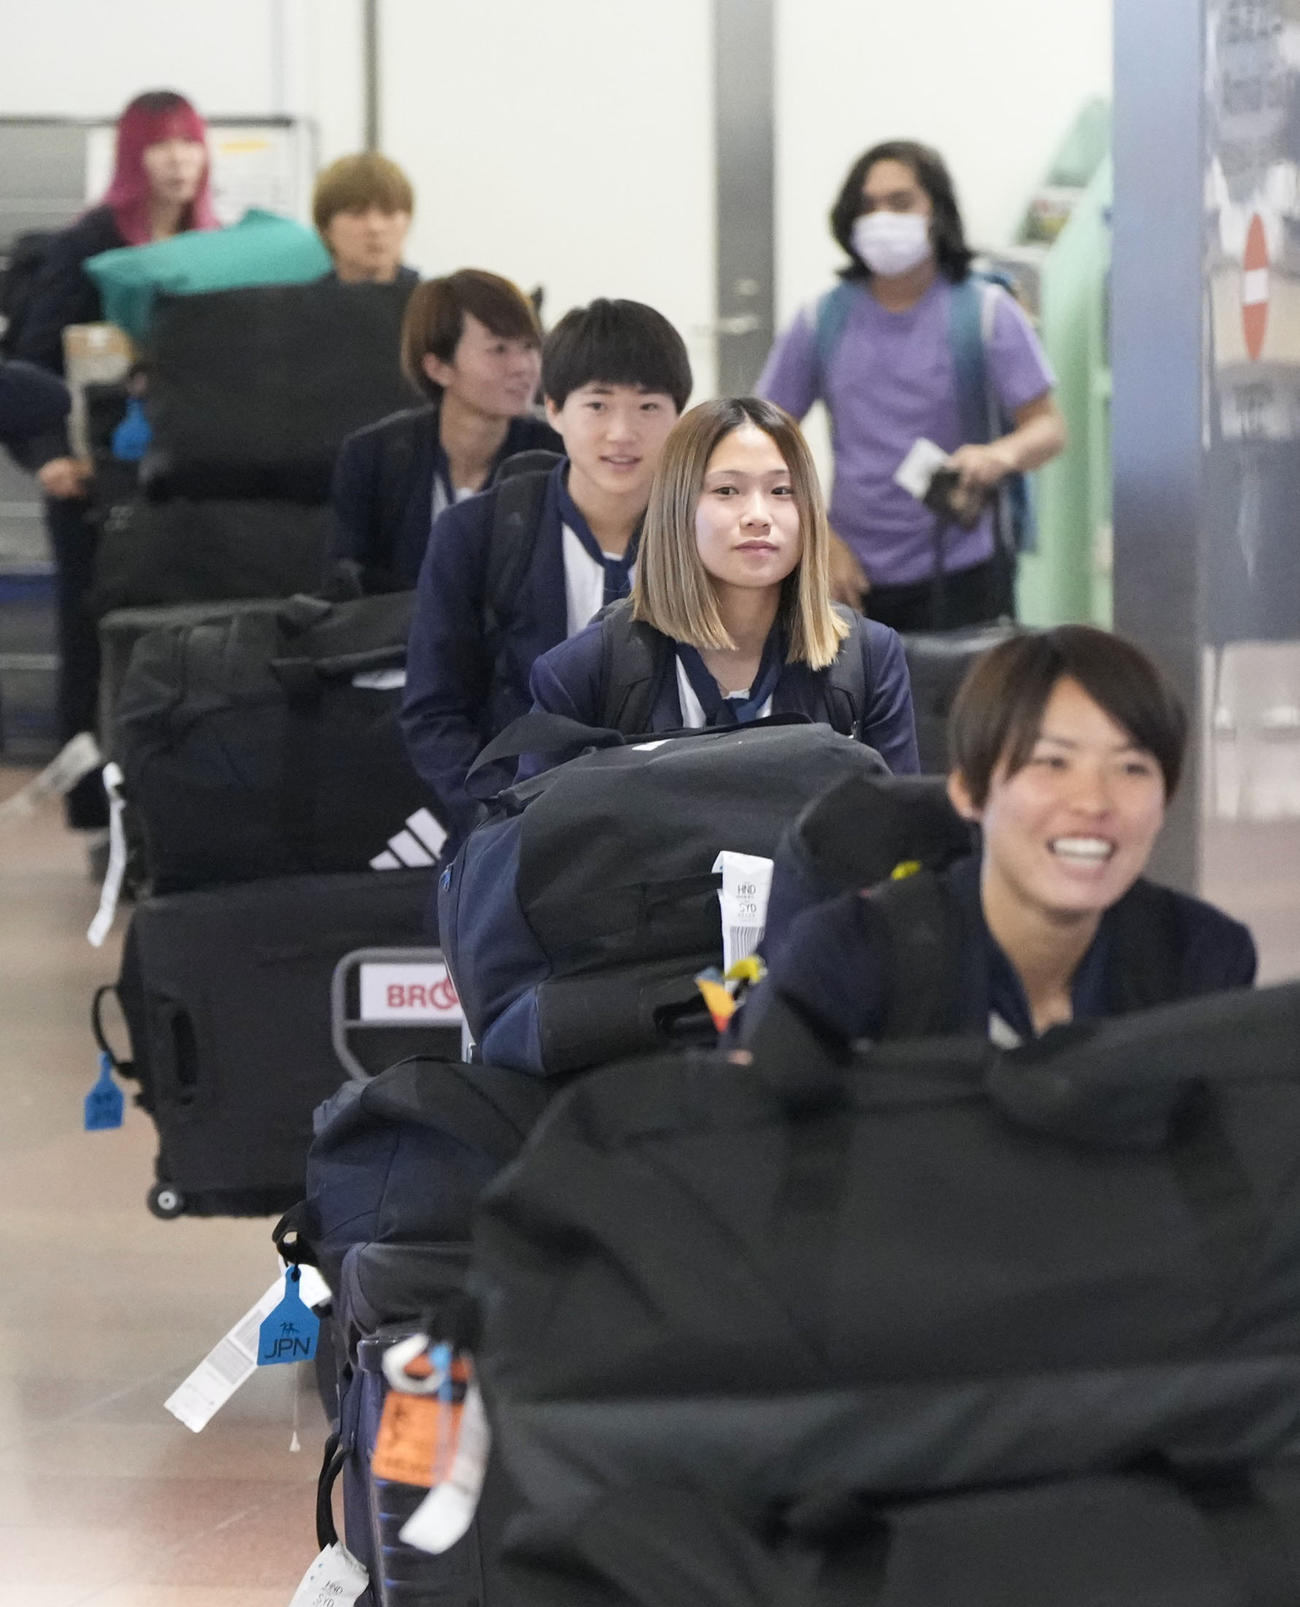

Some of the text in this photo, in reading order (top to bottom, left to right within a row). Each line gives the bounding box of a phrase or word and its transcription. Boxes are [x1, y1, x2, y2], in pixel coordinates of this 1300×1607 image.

[737, 884, 757, 896] HND
[739, 903, 757, 913] SYD
[264, 1336, 311, 1359] JPN
[324, 1580, 344, 1594] HND
